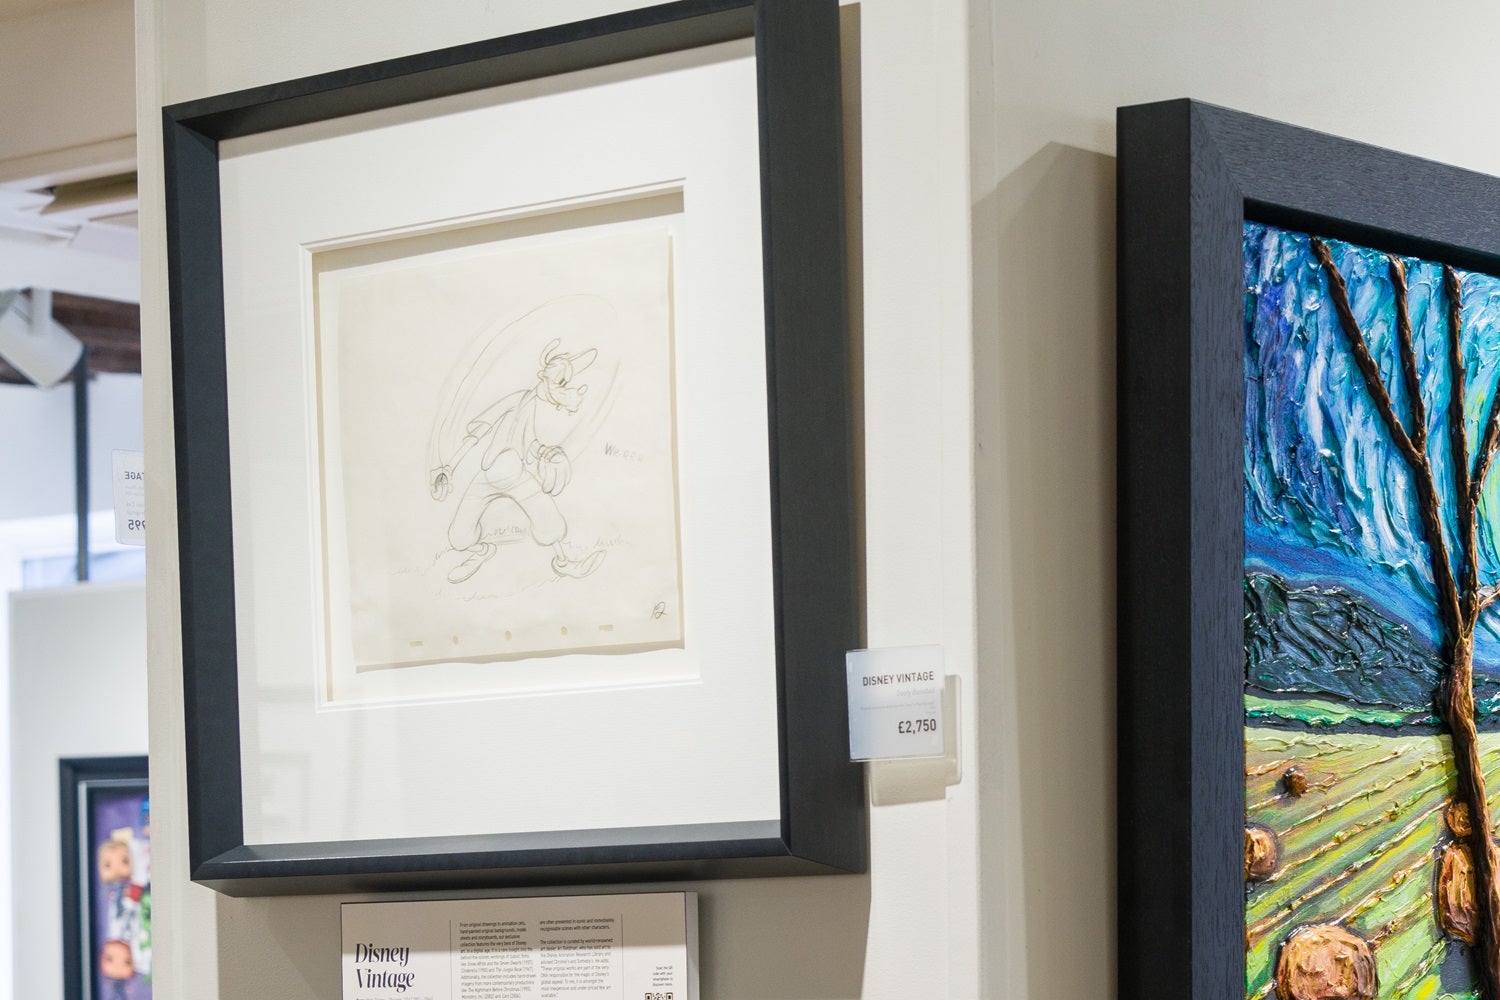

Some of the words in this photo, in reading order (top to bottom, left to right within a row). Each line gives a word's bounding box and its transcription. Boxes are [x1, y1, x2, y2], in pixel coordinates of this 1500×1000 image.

[863, 675, 894, 686] DISNEY
[897, 671, 935, 683] VINTAGE
[898, 719, 937, 734] £2,750
[355, 943, 410, 967] Disney
[356, 967, 415, 993] Vintage
